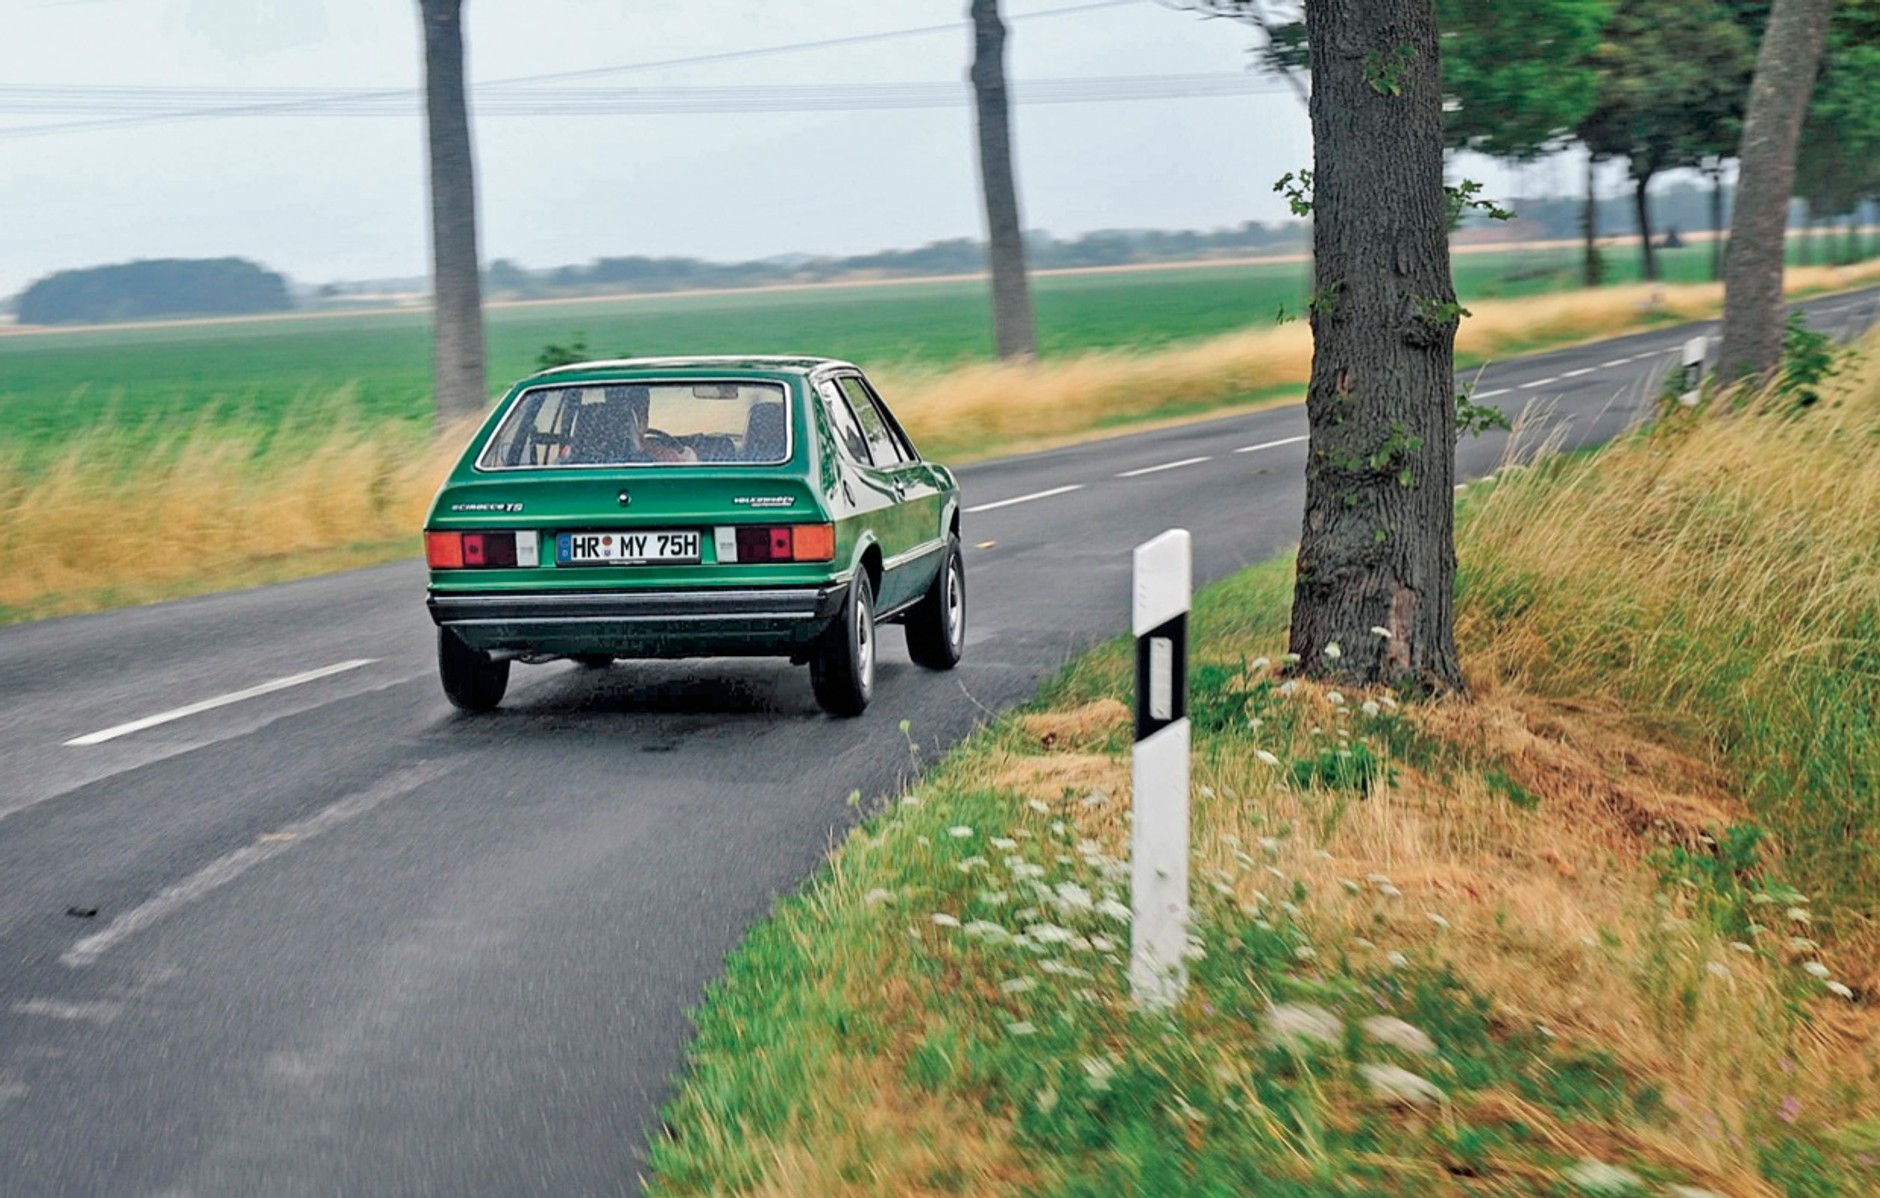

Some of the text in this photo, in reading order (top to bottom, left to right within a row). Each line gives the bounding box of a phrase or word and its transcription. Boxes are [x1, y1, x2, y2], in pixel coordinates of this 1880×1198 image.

[573, 537, 600, 558] HR
[620, 536, 648, 557] MY
[657, 534, 698, 556] 75H
